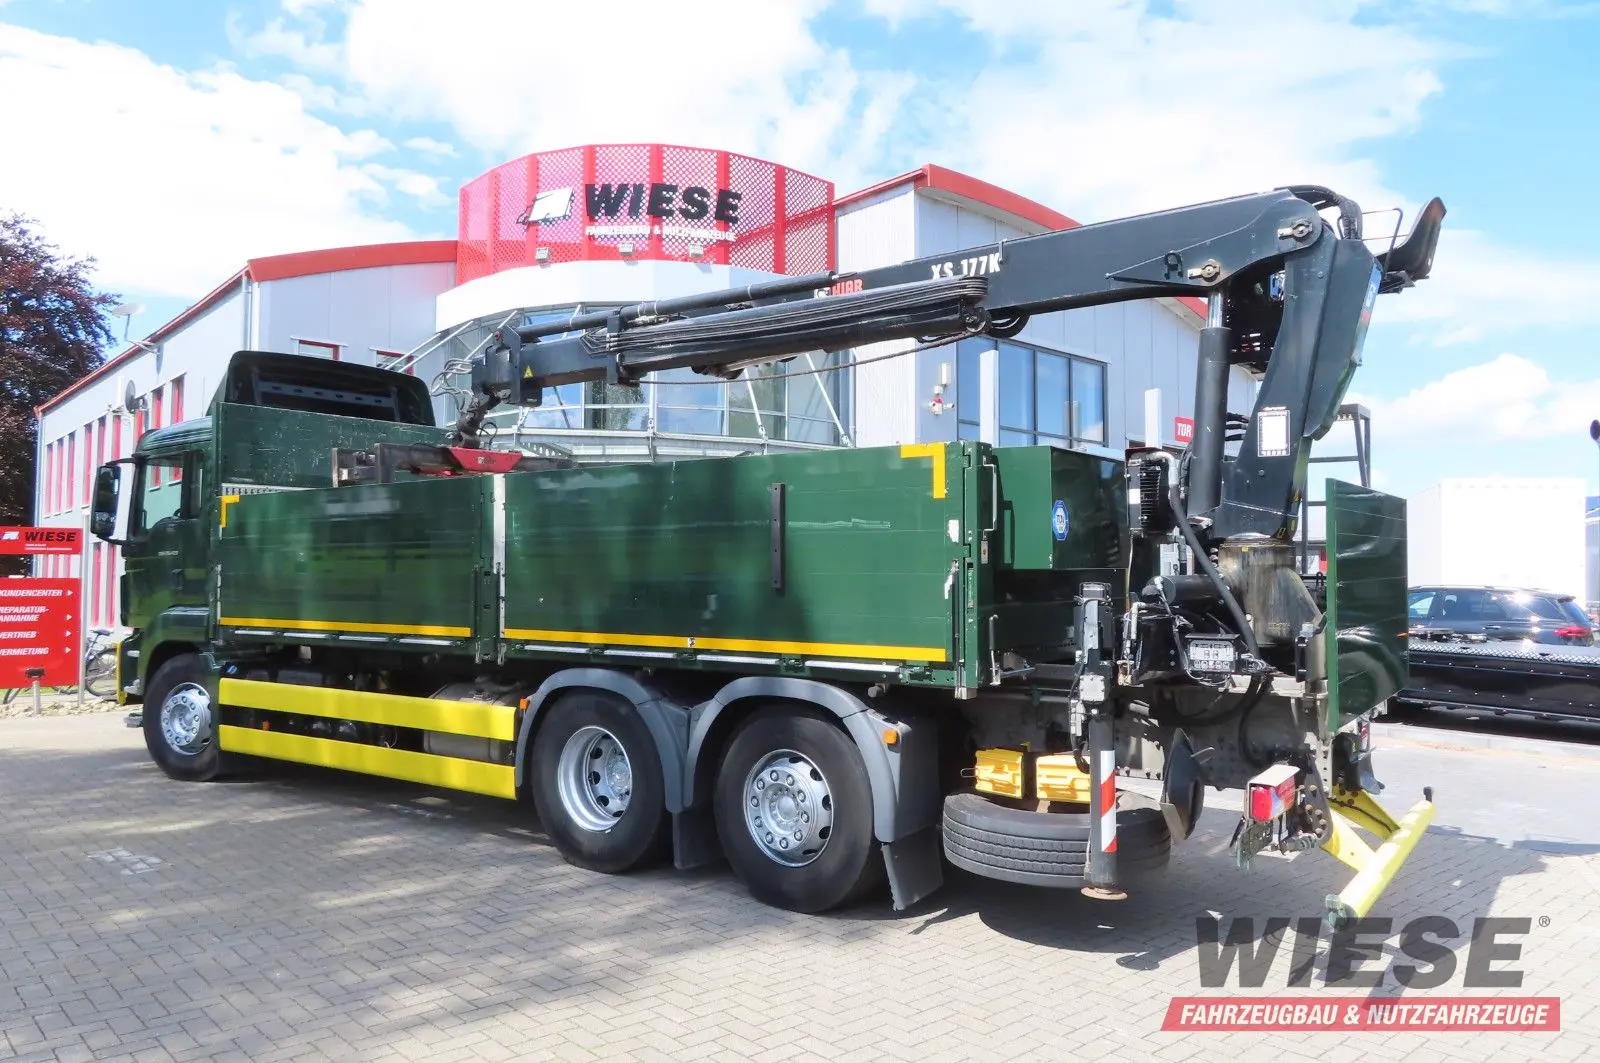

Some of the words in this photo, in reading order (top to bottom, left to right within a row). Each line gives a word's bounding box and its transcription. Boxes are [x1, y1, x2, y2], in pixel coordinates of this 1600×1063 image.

[585, 183, 742, 224] WIESE
[931, 261, 954, 280] XS
[961, 252, 1000, 277] 177K
[25, 531, 76, 542] WIESE
